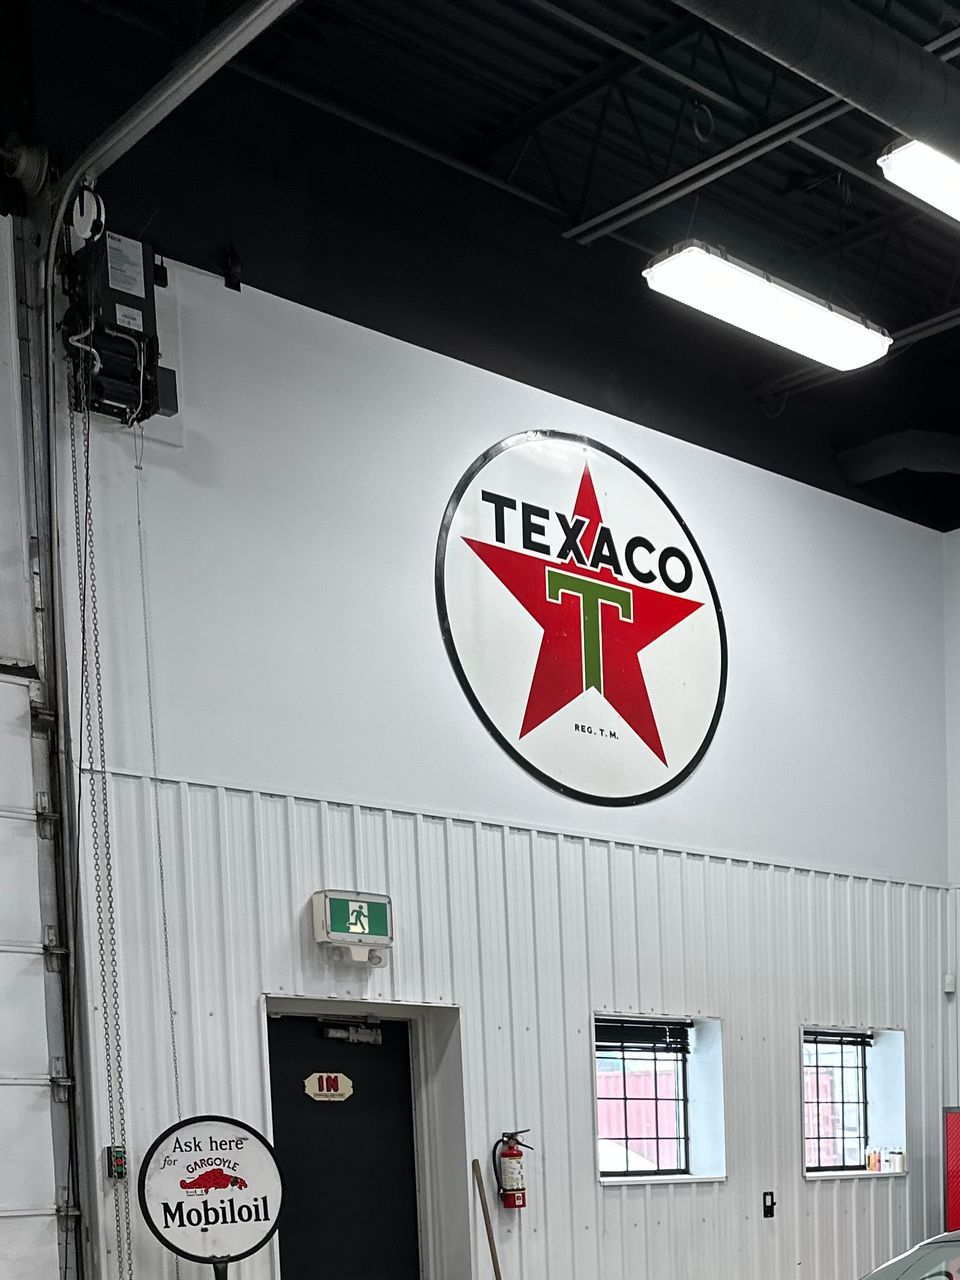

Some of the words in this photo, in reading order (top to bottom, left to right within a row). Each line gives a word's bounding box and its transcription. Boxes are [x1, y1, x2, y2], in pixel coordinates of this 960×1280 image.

[481, 489, 694, 594] TEXACO
[546, 569, 633, 696] T
[574, 723, 597, 736] REG.
[317, 1075, 339, 1093] IN
[172, 1136, 203, 1153] Ask
[209, 1136, 244, 1152] here
[160, 1156, 179, 1170] for
[186, 1157, 240, 1174] GARGOYLE
[161, 1195, 271, 1229] Mobiloil
